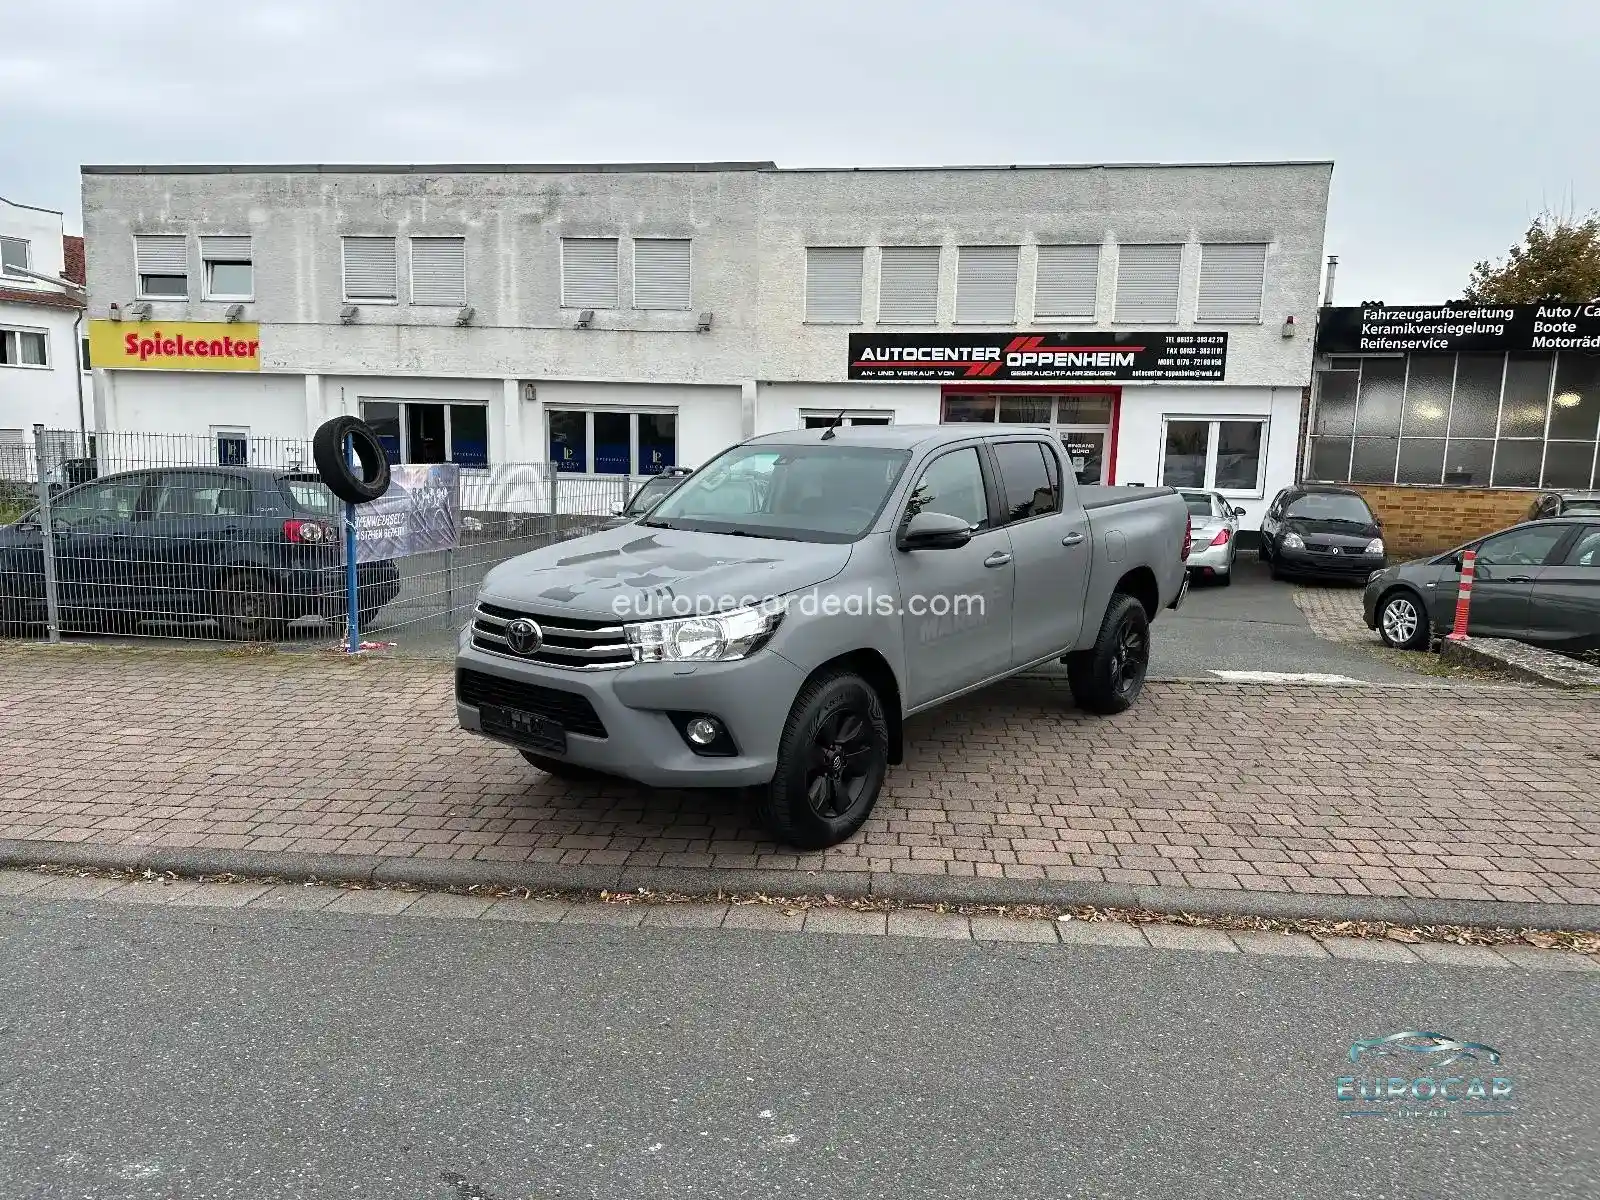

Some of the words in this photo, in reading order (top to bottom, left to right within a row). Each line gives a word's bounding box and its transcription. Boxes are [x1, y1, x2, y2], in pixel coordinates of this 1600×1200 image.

[1363, 307, 1514, 322] Fahrzeugaufbereitung
[1536, 306, 1571, 318] Auto
[1361, 322, 1504, 336] Keramikversiegelung
[1534, 321, 1577, 333] Boote
[125, 331, 259, 361] Spielcenter
[1360, 337, 1449, 349] Reifenservice
[860, 347, 1001, 361] AUTOCENTER
[1006, 352, 1135, 367] OPPENHEIM
